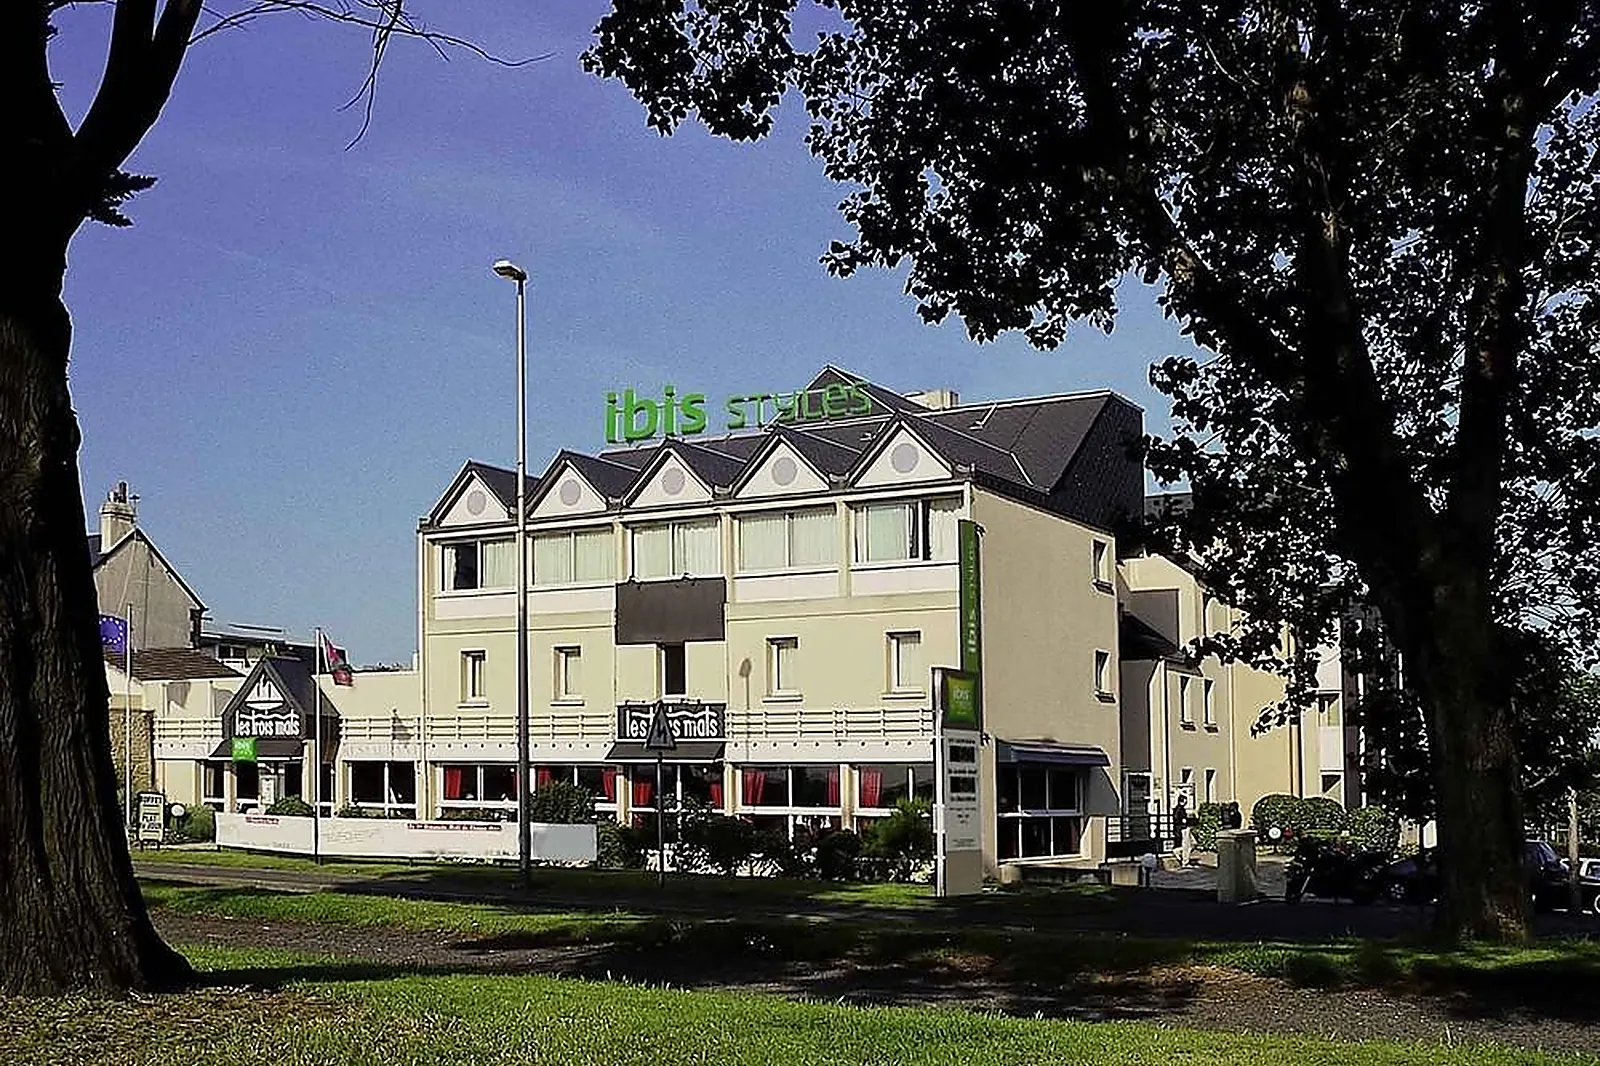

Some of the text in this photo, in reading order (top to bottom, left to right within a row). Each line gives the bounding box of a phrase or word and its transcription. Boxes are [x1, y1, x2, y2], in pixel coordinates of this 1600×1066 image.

[604, 384, 707, 444] ibis
[235, 709, 251, 736] les
[251, 709, 274, 736] trois
[626, 709, 648, 737] les
